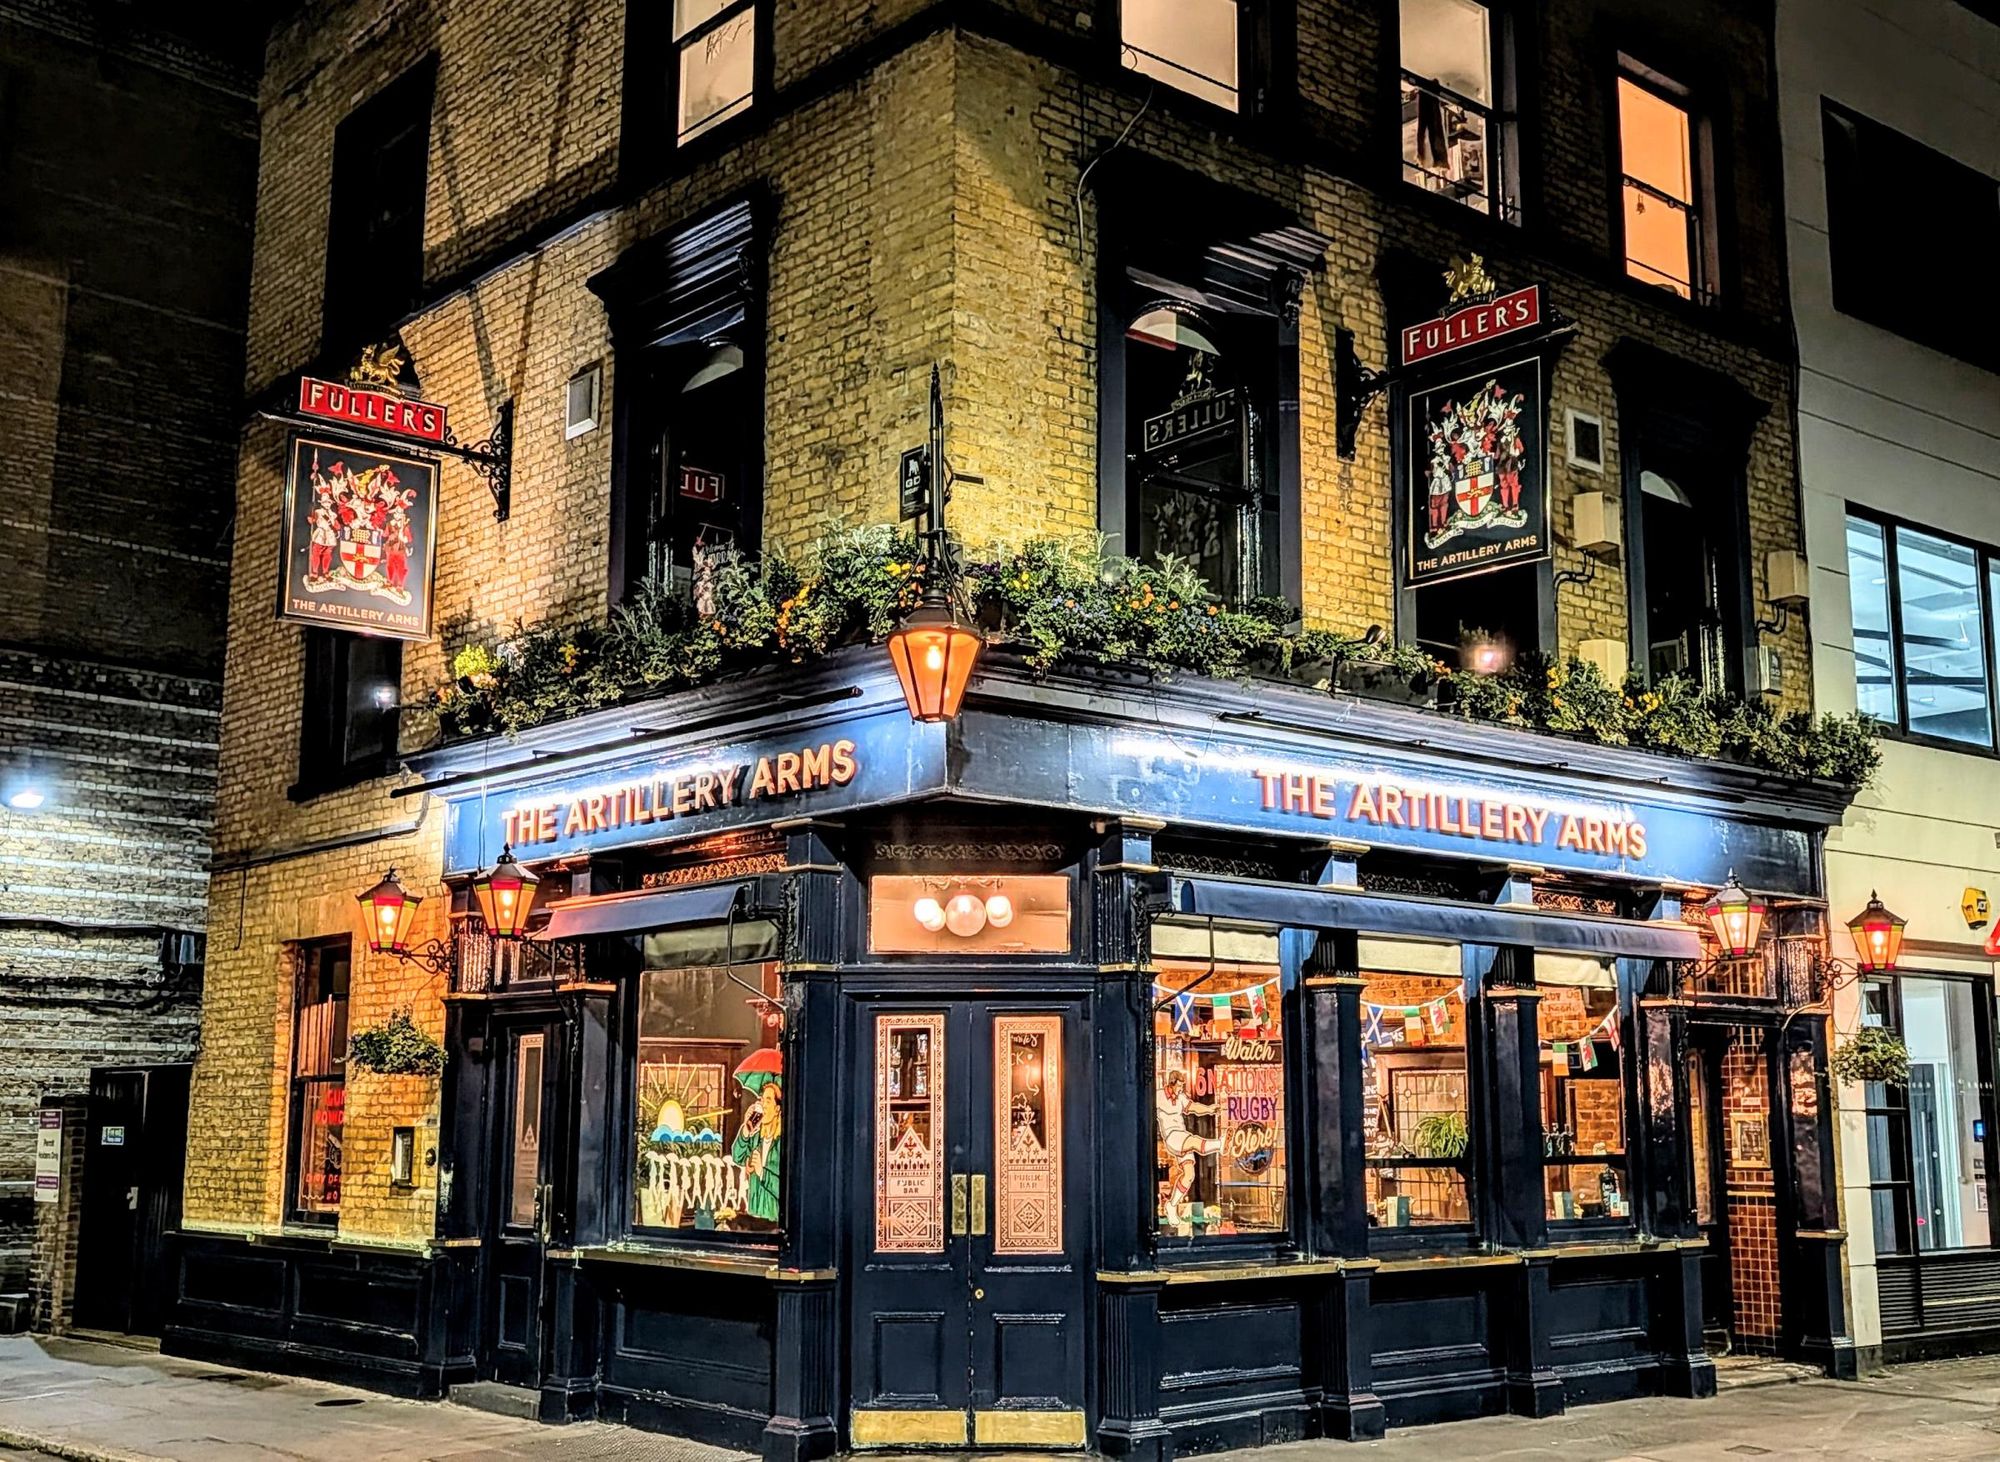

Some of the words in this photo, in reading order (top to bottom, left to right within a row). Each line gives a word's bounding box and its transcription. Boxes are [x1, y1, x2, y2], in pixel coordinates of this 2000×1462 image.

[1409, 298, 1530, 356] FULLER'S
[309, 385, 436, 434] FULLER'S
[1417, 558, 1438, 571] THE
[1440, 544, 1501, 566] ARTILLERY
[1505, 536, 1538, 552] ARMS
[293, 598, 315, 612] THE
[319, 603, 384, 621] ARTILLERY
[386, 613, 419, 627] ARMS
[501, 803, 557, 845] THE
[563, 764, 740, 835] ARTILLERY
[749, 739, 857, 800] ARMS
[1254, 769, 1336, 818] THE
[1348, 783, 1549, 844] ARTILLERY
[1558, 814, 1647, 859] ARMS
[1225, 1036, 1276, 1061] Watch
[1228, 1097, 1277, 1120] RUGBY
[1232, 1122, 1278, 1157] Here!
[897, 1179, 925, 1187] PUBLIC
